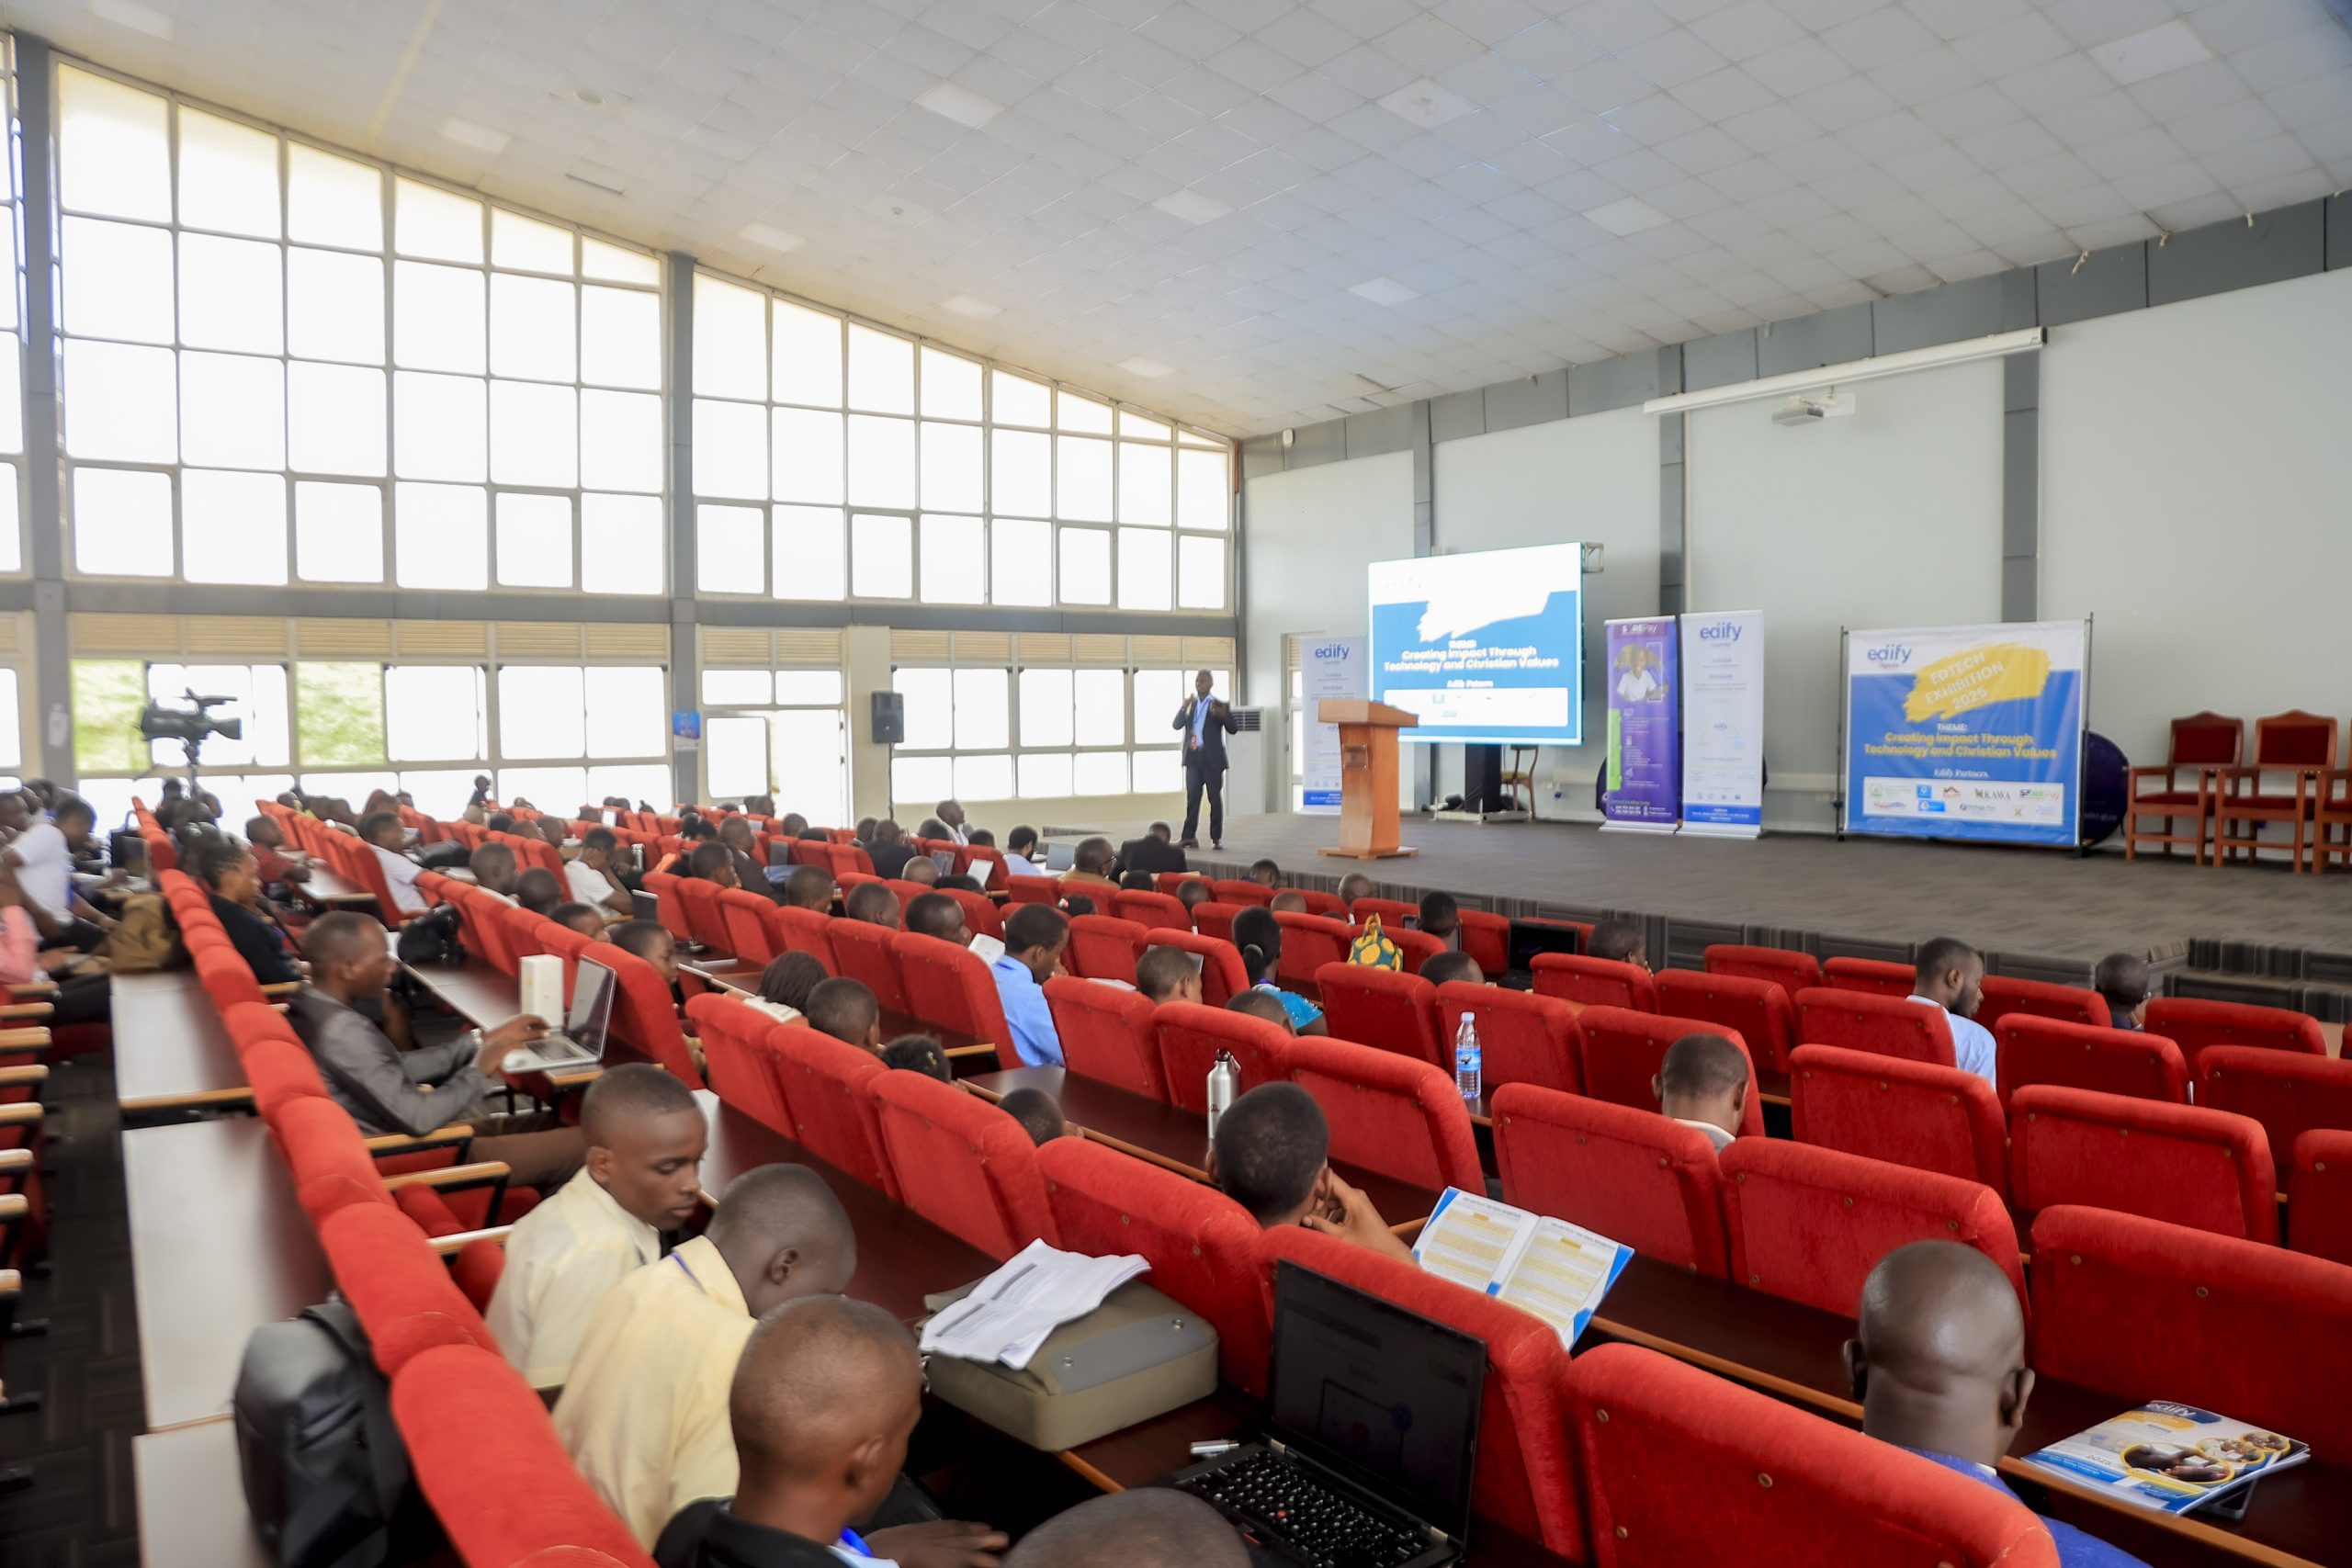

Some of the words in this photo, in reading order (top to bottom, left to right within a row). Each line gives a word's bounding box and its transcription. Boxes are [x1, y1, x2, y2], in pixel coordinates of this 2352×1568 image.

[1700, 623, 1742, 641] edify
[1315, 644, 1350, 660] edify
[1867, 644, 1912, 663] edify
[1930, 651, 1985, 684] EDTECH
[1926, 660, 2005, 705] EXHIBITION
[1885, 733, 1934, 745] Creating
[1982, 734, 2033, 746] Through
[1865, 744, 1928, 758] Technology
[1930, 745, 1953, 756] and
[1955, 746, 2011, 757] Christian
[2014, 747, 2057, 759] Values
